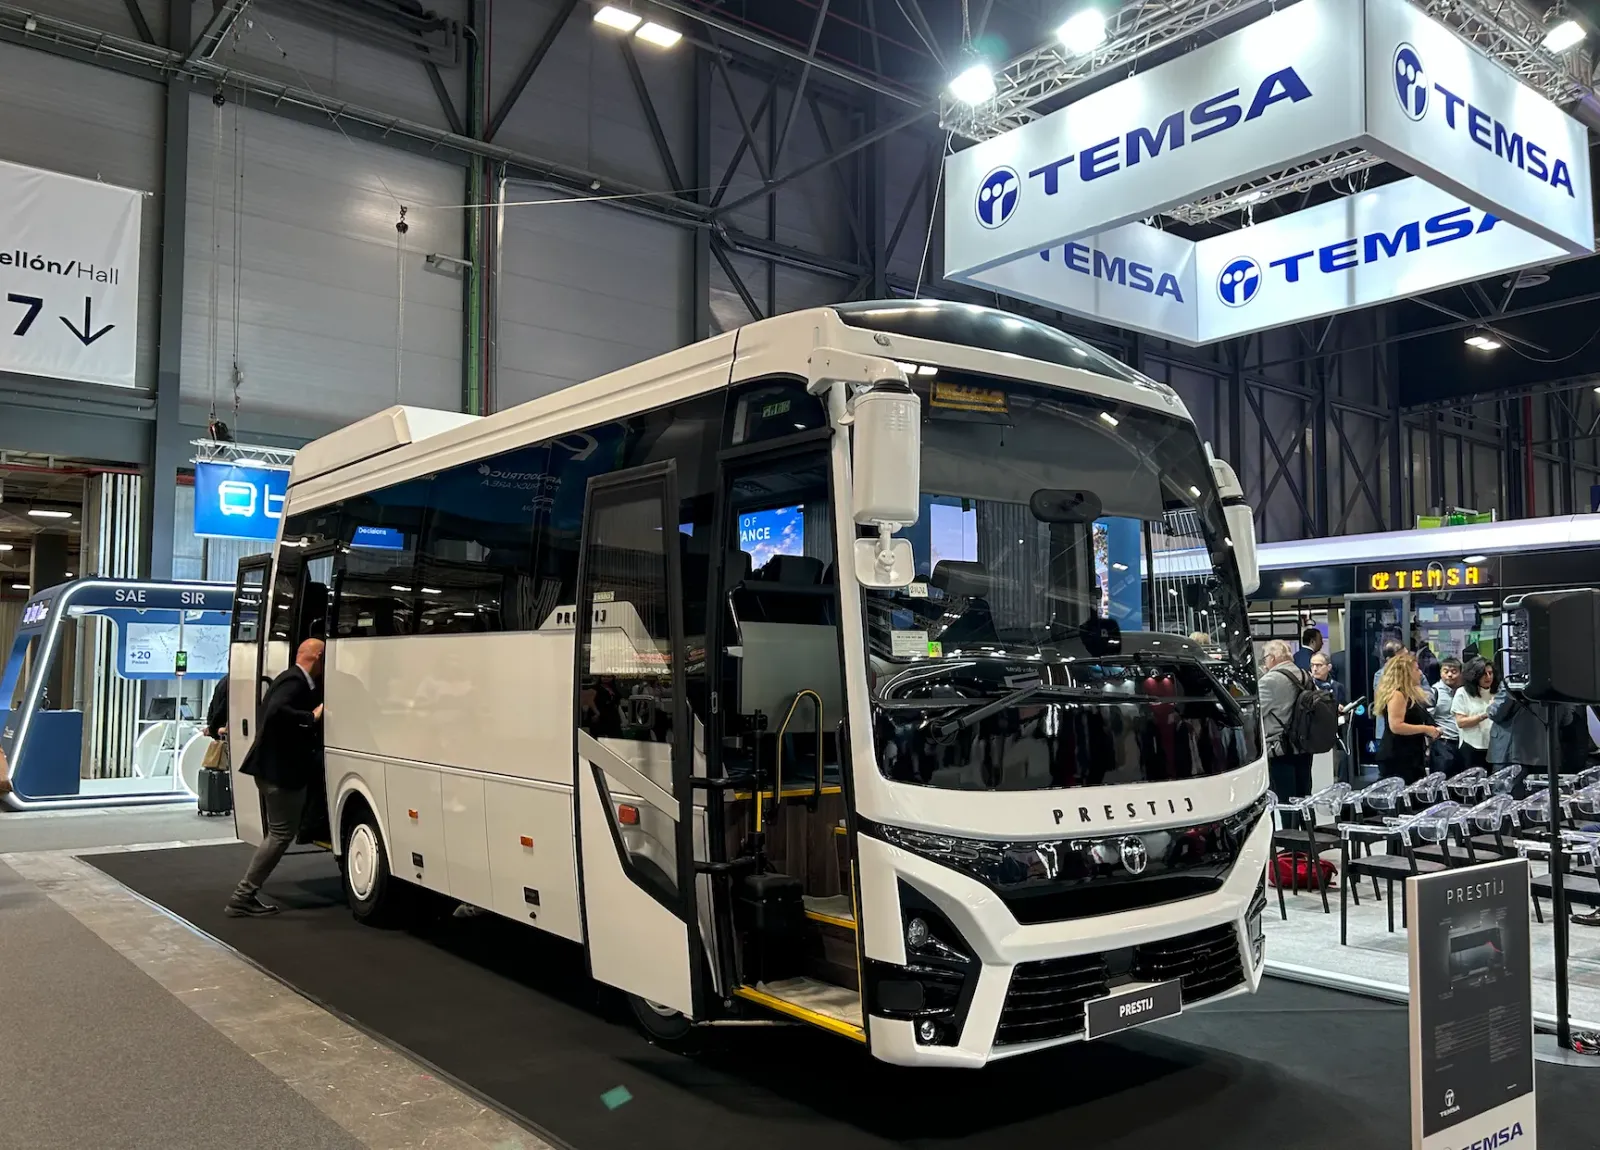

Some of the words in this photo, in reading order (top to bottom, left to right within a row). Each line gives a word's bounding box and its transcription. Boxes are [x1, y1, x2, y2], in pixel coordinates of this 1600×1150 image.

[1028, 66, 1313, 196] TEMSA
[1434, 82, 1576, 199] TEMSA
[1039, 241, 1184, 303] EMSA
[7, 293, 44, 336] 7
[743, 517, 757, 528] OF
[740, 527, 770, 542] ANCE
[1395, 566, 1479, 589] TEMSA
[115, 589, 146, 602] SAE
[181, 592, 205, 605] SIR
[130, 651, 151, 660] +20
[1052, 797, 1193, 825] PRESTIJ
[1119, 997, 1154, 1018] PRESTIJ
[1439, 1105, 1460, 1117] TEMSA
